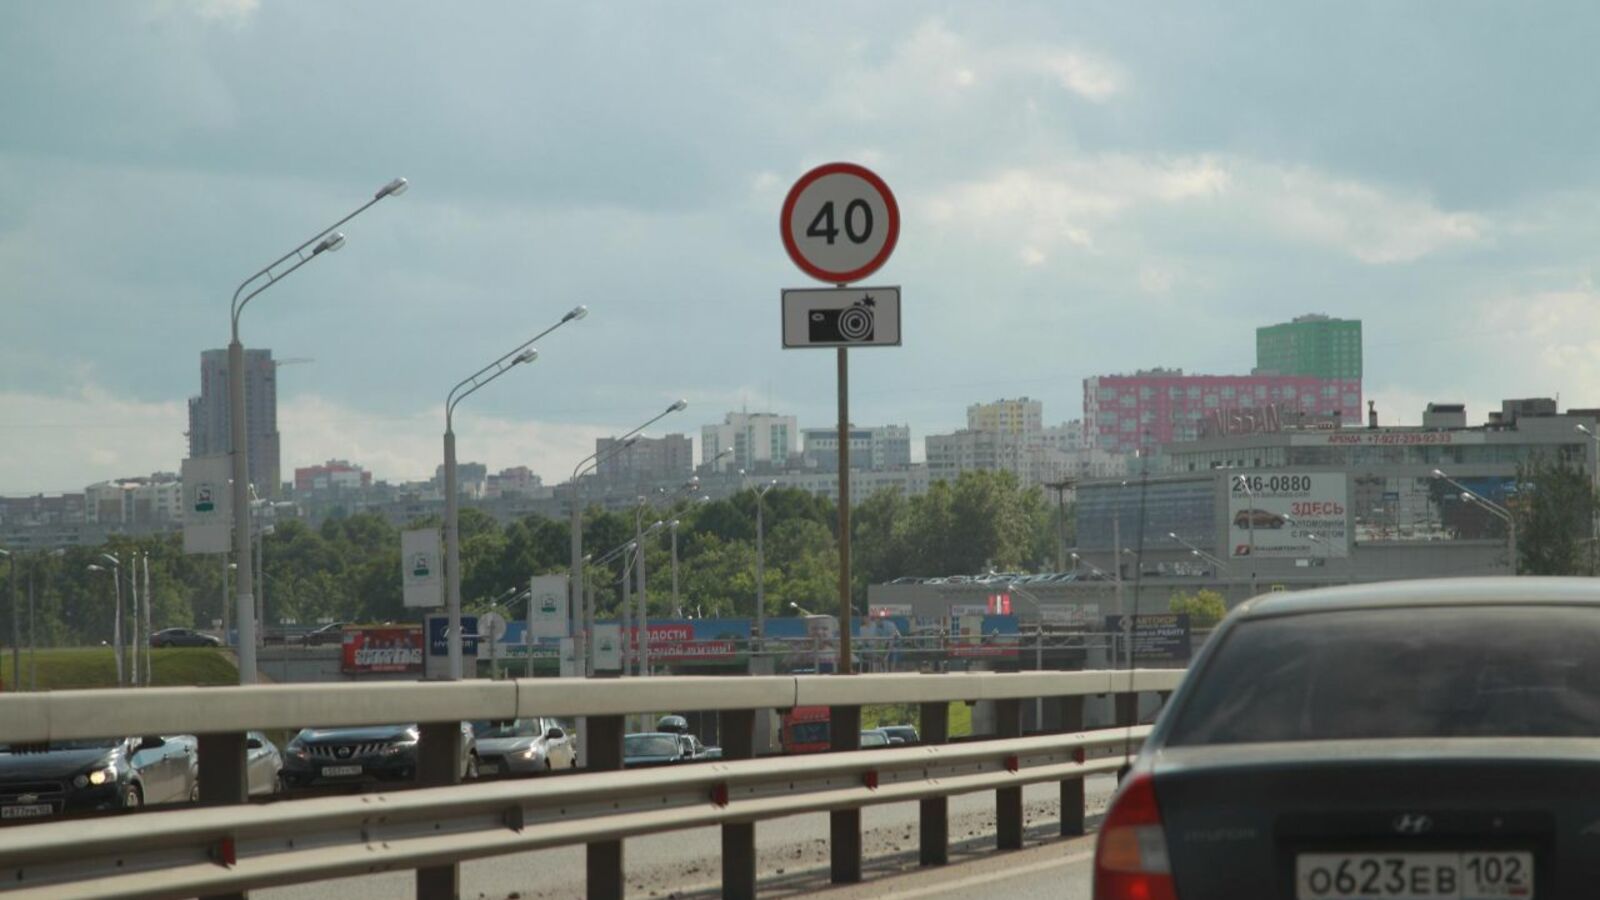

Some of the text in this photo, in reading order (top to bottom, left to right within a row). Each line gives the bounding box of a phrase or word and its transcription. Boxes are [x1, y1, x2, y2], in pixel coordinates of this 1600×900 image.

[806, 199, 873, 245] 40
[1215, 403, 1281, 434] NISSAN
[1328, 435, 1361, 443] АРЕНДА
[1232, 475, 1311, 491] 246-0880
[1291, 502, 1344, 515] ЗДЕСЬ
[1309, 856, 1523, 895] О623ЕВ 102
